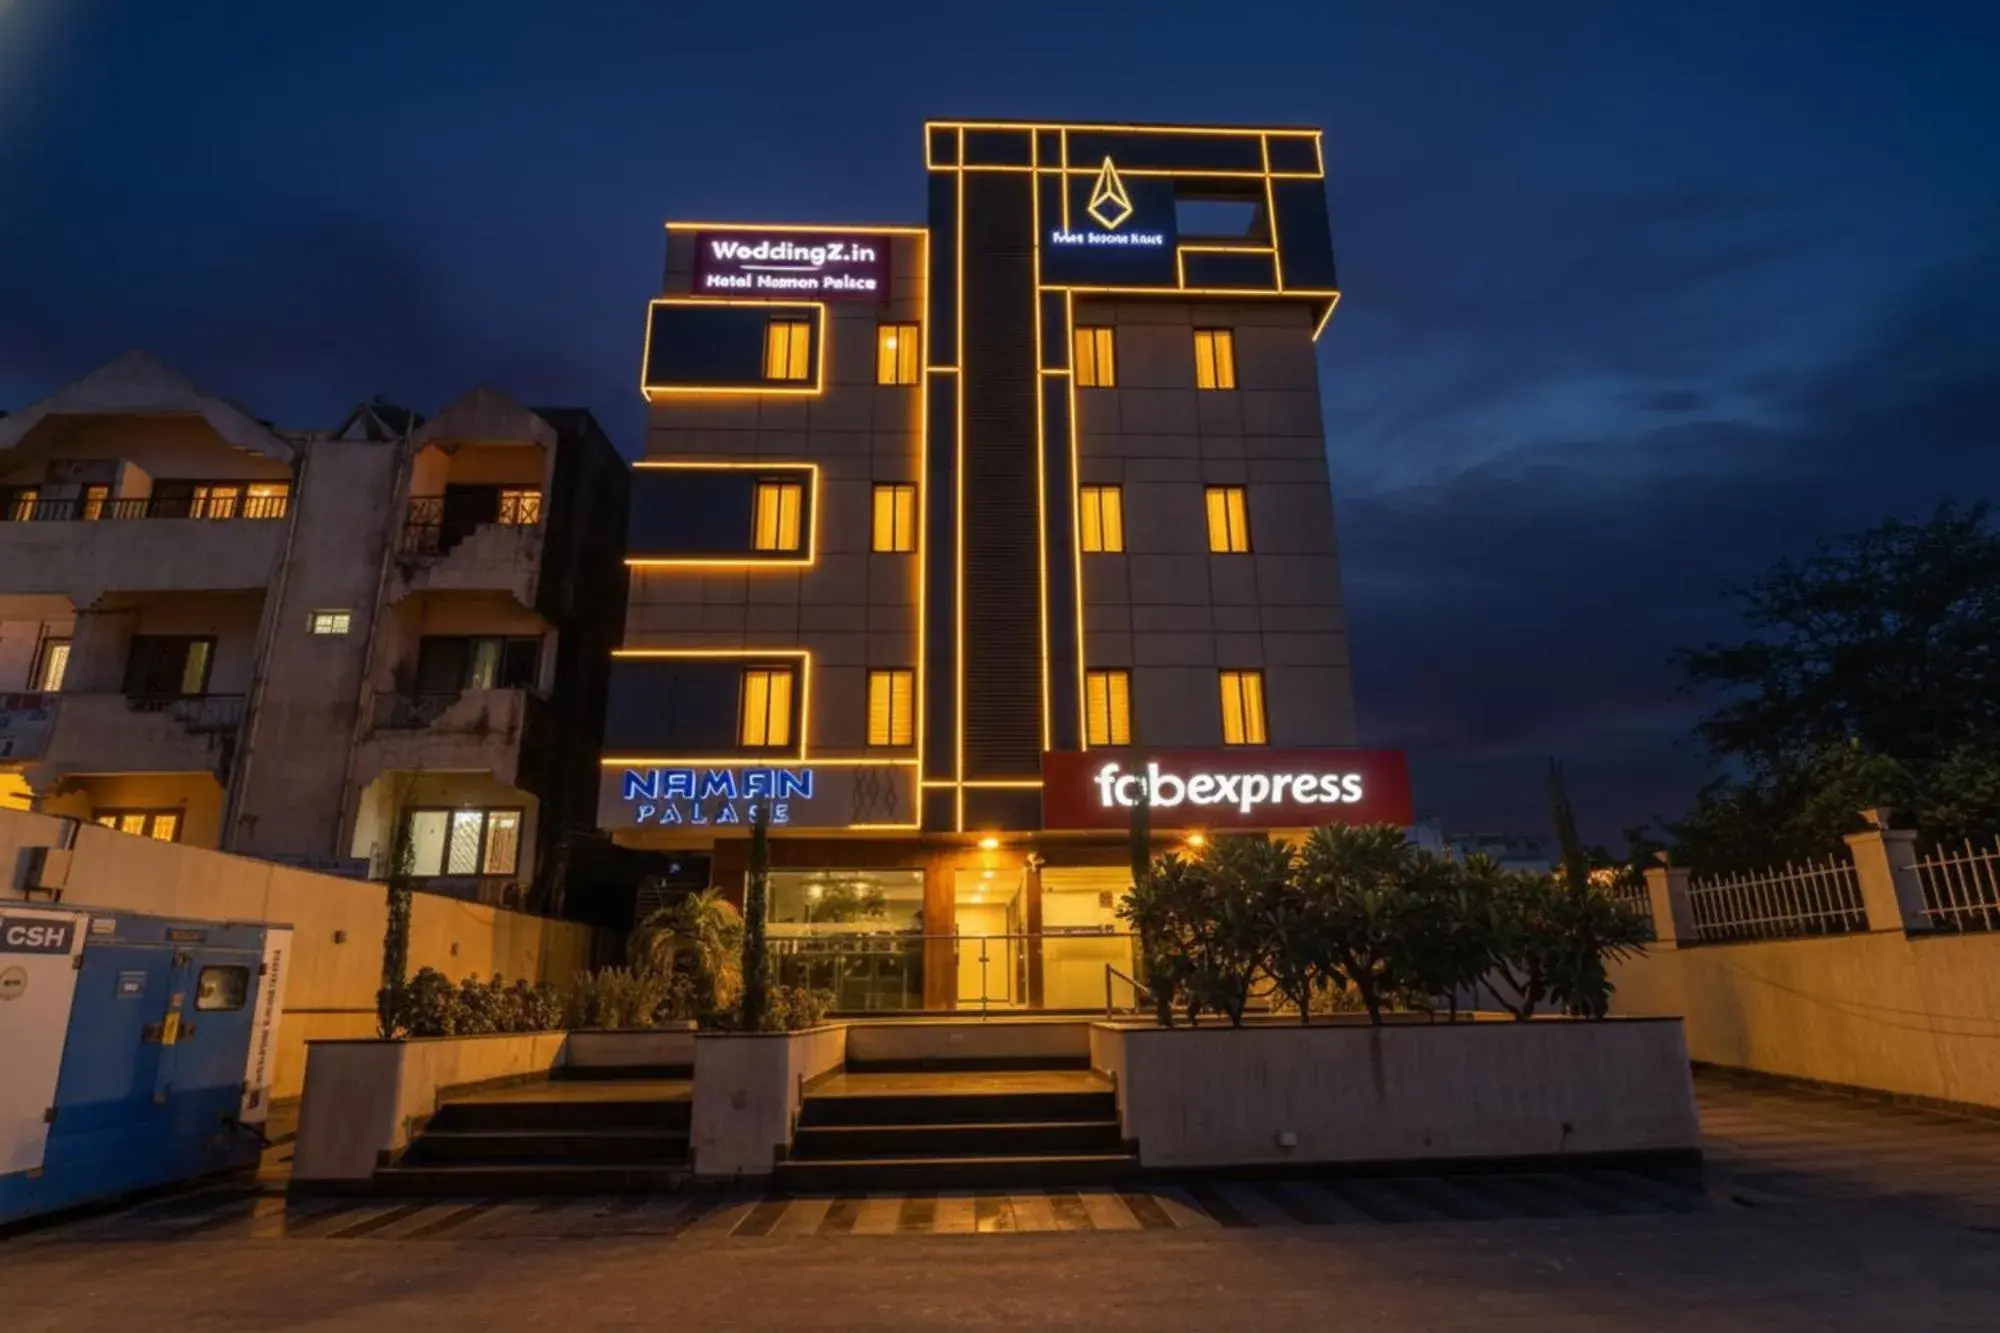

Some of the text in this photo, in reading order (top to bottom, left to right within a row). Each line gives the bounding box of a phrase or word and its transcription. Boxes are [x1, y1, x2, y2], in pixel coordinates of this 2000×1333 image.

[711, 240, 876, 265] WeddingZ.in
[623, 768, 813, 799] NAMAN
[1093, 762, 1363, 812] fabexpress
[6, 925, 65, 947] CSH
